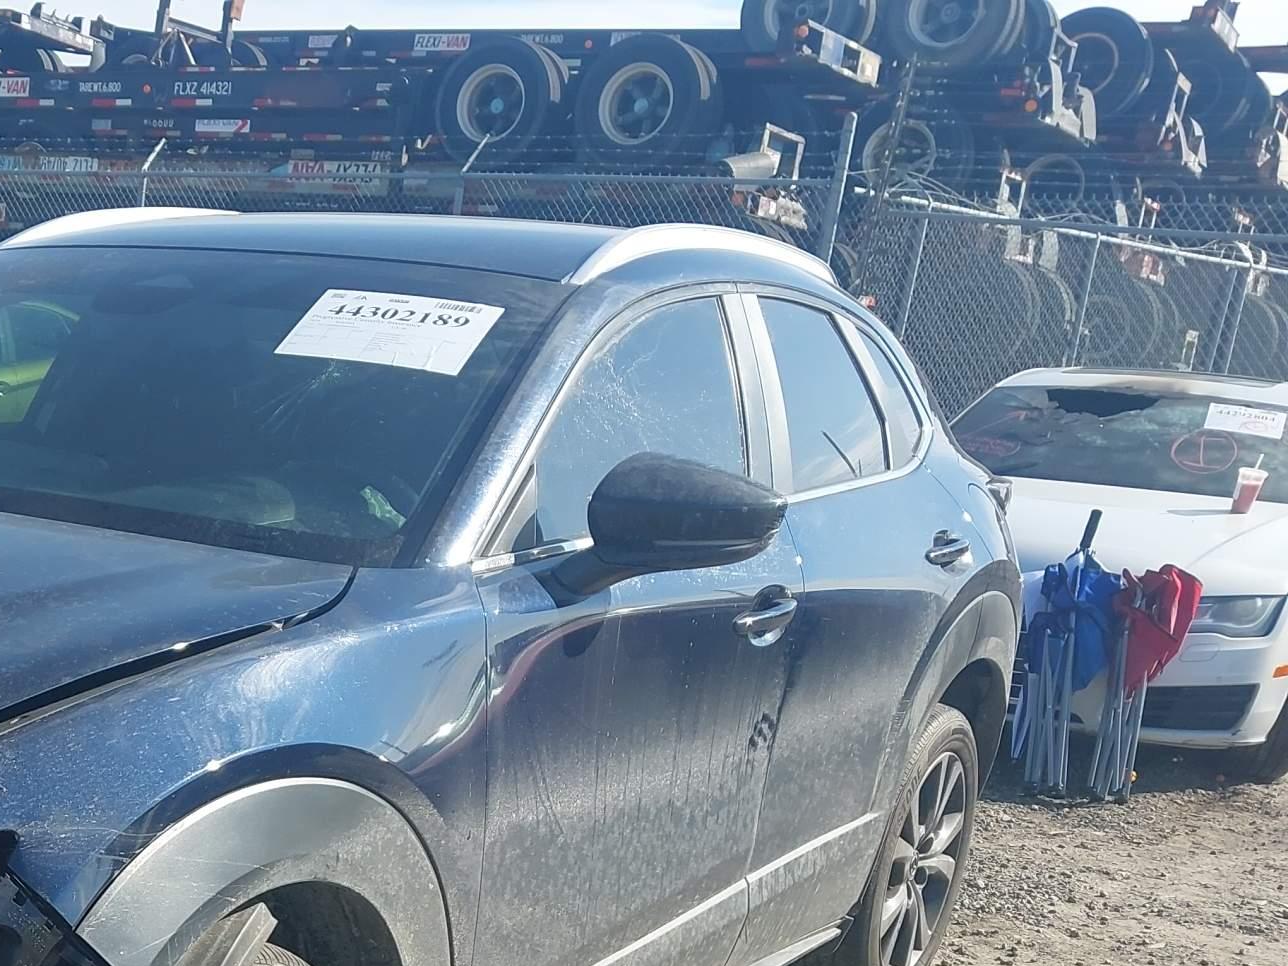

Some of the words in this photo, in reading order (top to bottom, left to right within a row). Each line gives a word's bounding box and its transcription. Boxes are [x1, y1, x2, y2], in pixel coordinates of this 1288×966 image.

[414, 34, 470, 50] FLEXI-VAN
[174, 81, 197, 95] FLXZ
[200, 81, 232, 96] 414321
[328, 303, 471, 328] 44302189
